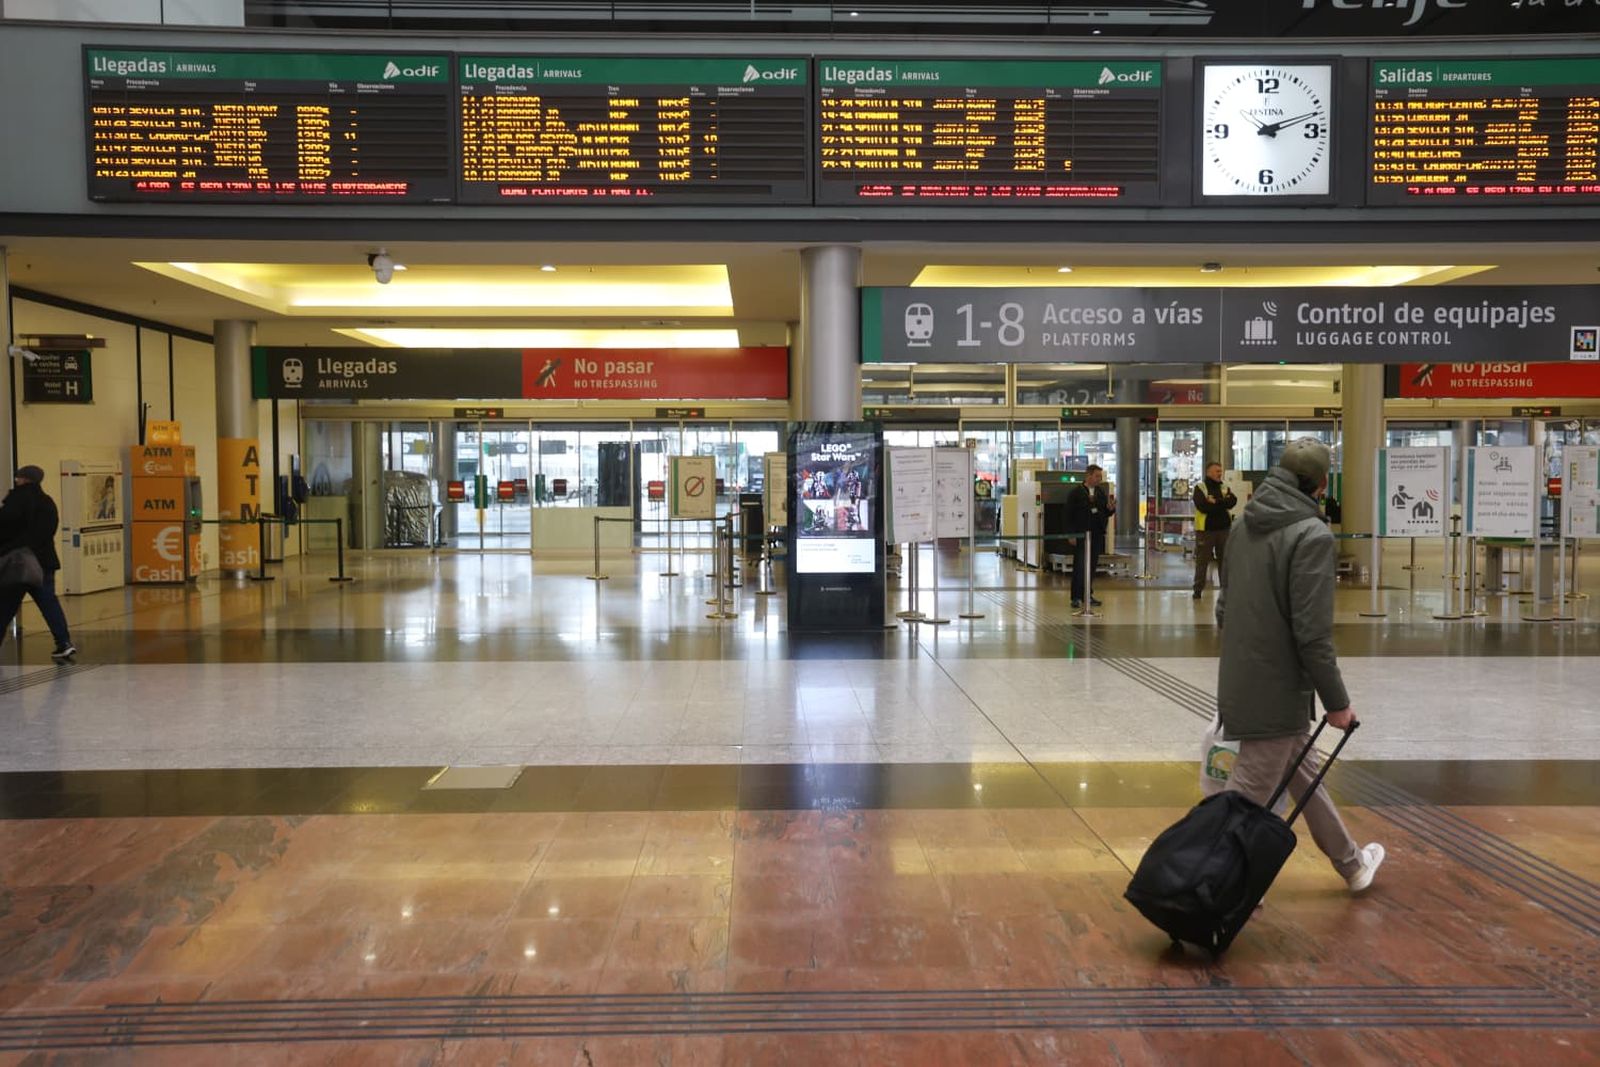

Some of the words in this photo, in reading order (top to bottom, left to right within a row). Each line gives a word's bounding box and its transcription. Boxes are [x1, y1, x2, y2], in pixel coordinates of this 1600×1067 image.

[93, 57, 166, 75] Llegadas
[176, 63, 216, 73] ARRIVALS
[403, 64, 440, 77] adif
[464, 63, 534, 82] Llegadas
[543, 69, 582, 78] ARRIVALS
[762, 67, 797, 80] adif
[824, 66, 893, 84] Llegadas
[902, 71, 940, 80] ARRIVALS
[1117, 70, 1153, 82] adif
[1379, 68, 1433, 83] Salidas
[1443, 73, 1492, 81] DEPARTURES
[1256, 78, 1279, 94] 12
[1214, 124, 1229, 139] 9
[1304, 124, 1319, 139] 3
[1258, 169, 1274, 184] 6
[1042, 302, 1122, 325] Acceso
[1132, 308, 1145, 325] a
[1155, 300, 1203, 325] vías
[1296, 302, 1384, 324] Control
[1394, 302, 1424, 324] de
[1434, 300, 1556, 329] equipajes
[956, 303, 1025, 347] 1-8
[1042, 332, 1136, 347] PLATFORMS
[1296, 331, 1373, 346] LUGGAGE
[1378, 331, 1452, 346] CONTROL
[317, 357, 398, 377] Llegadas
[574, 358, 597, 374] No
[604, 361, 654, 377] pasar
[1452, 363, 1473, 374] No
[1481, 363, 1529, 376] pasar
[66, 381, 78, 396] H
[319, 379, 369, 389] ARRIVALS
[574, 379, 589, 388] NO
[590, 379, 657, 388] TRESPASSING
[1450, 378, 1464, 388] NO
[1466, 378, 1533, 388] TRESPASSING
[143, 448, 173, 457] ATM
[811, 452, 831, 461] Star
[143, 499, 175, 510] ATM
[136, 565, 183, 582] Cash
